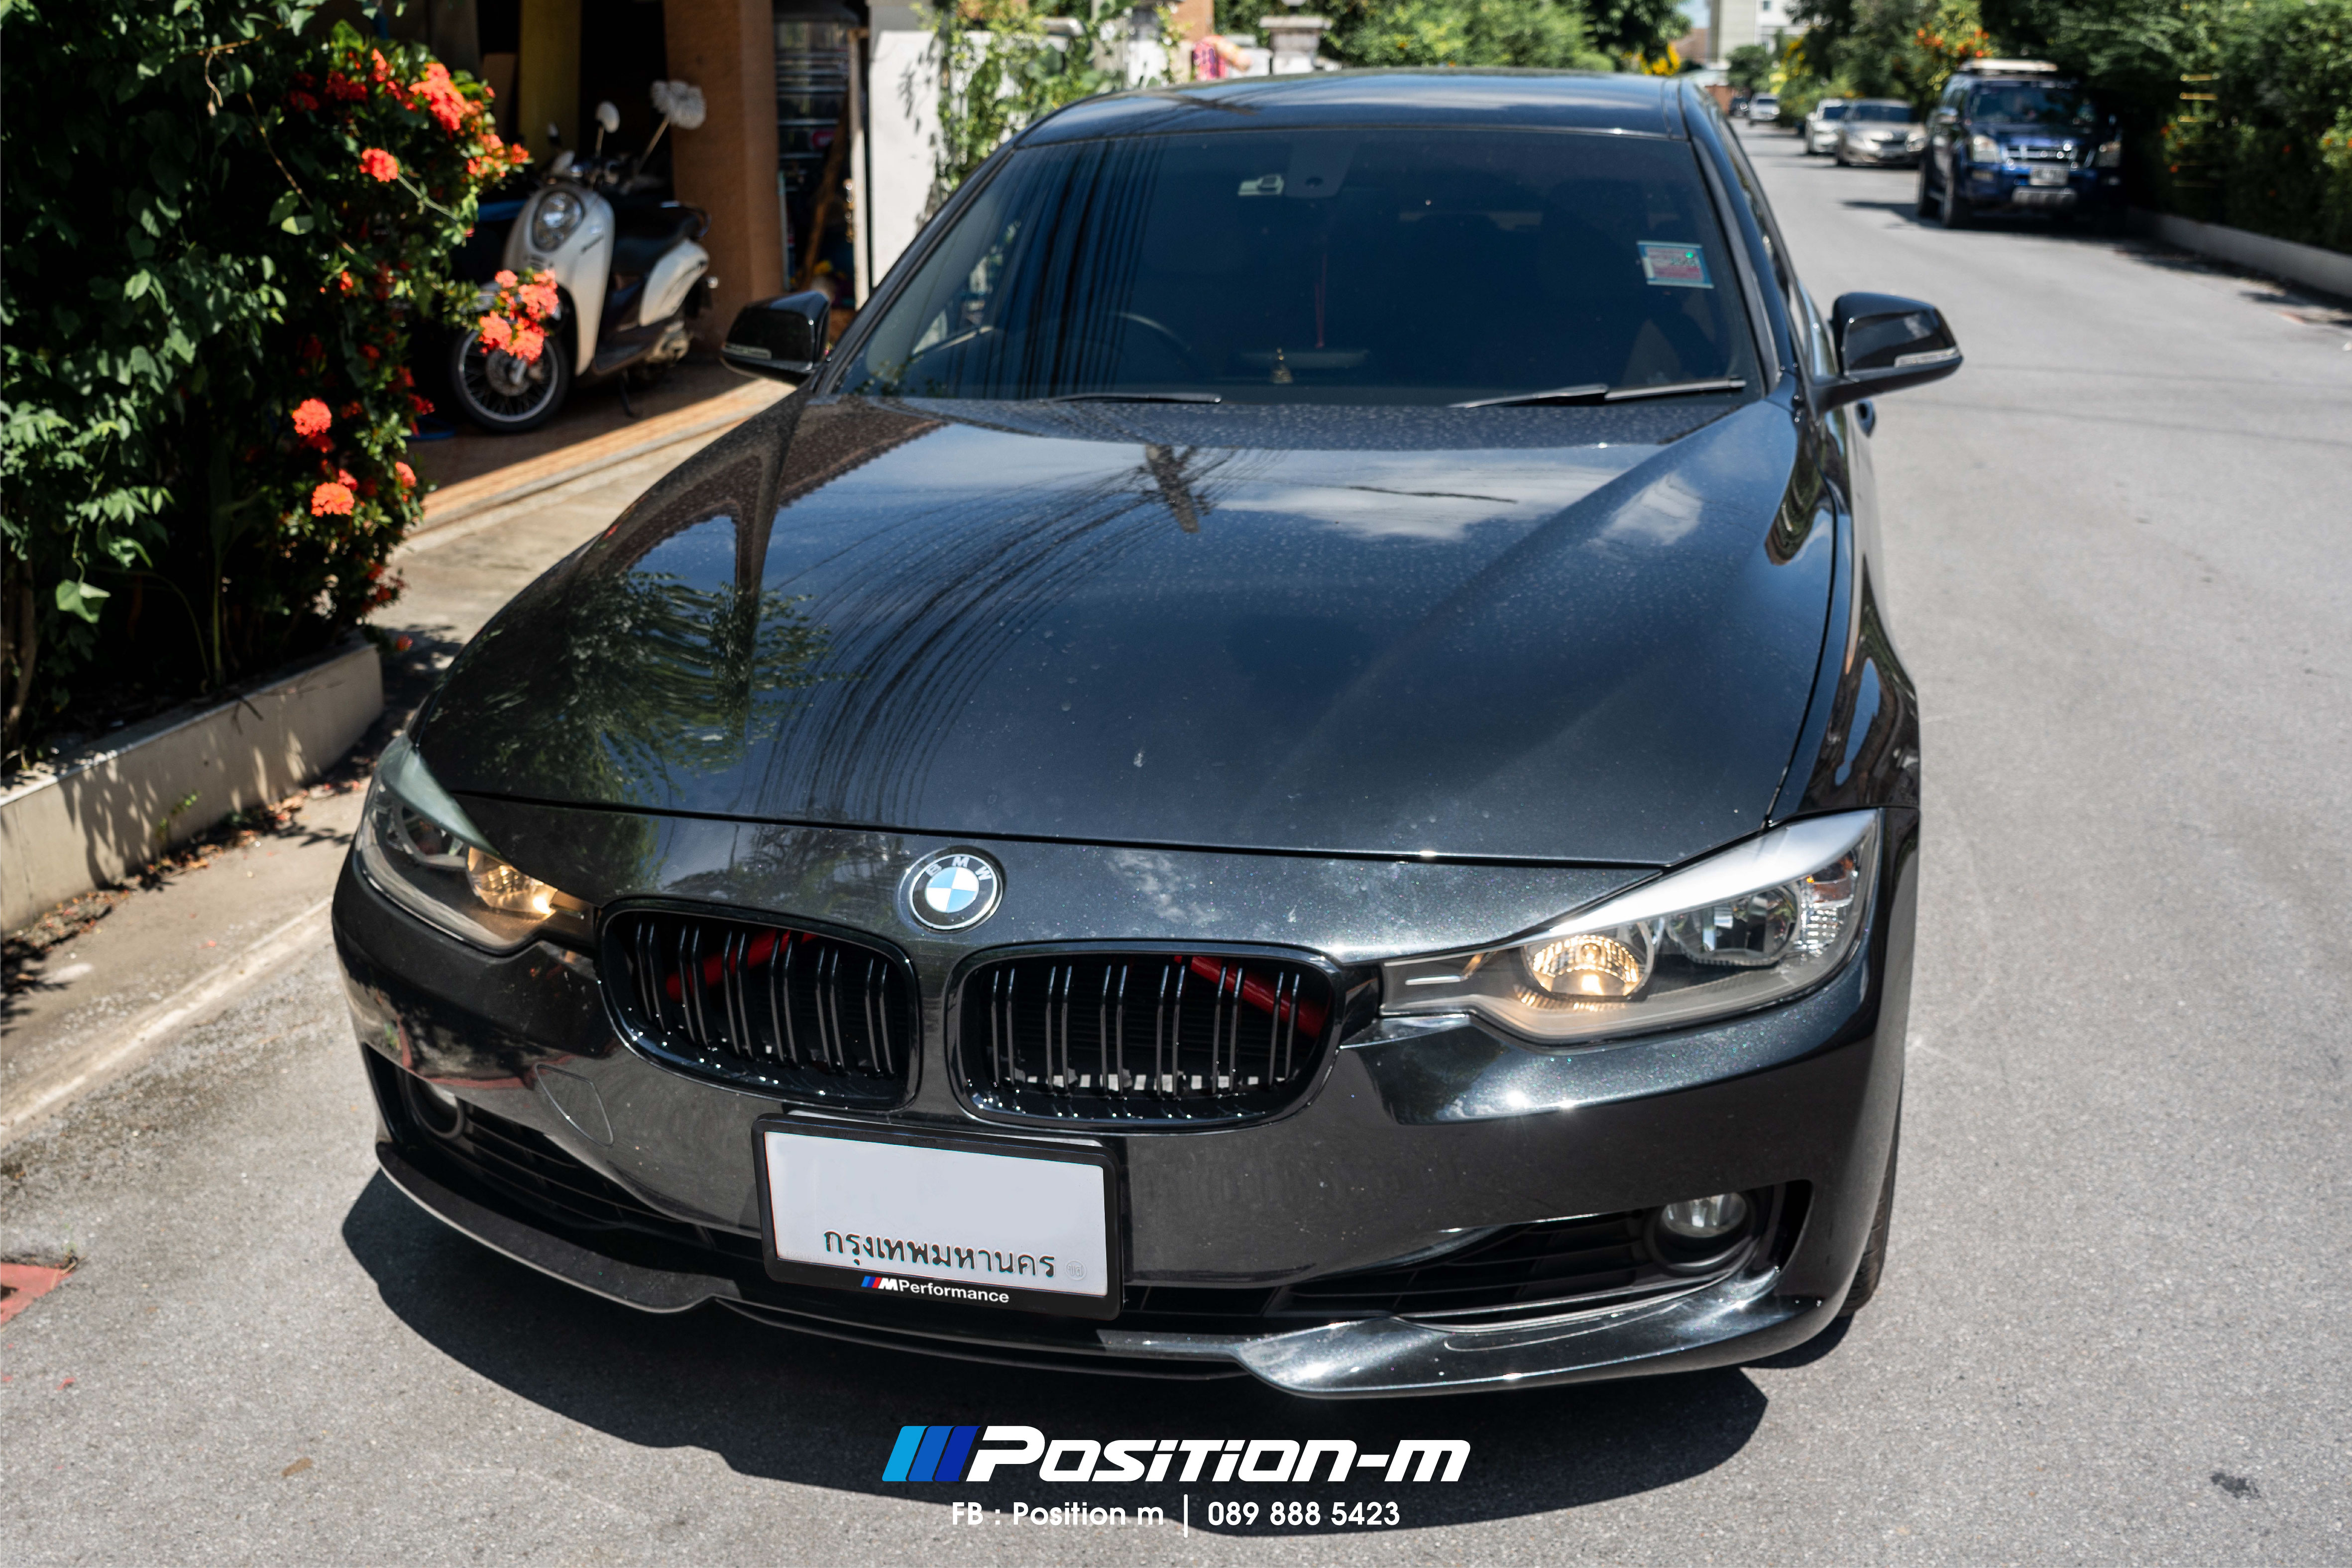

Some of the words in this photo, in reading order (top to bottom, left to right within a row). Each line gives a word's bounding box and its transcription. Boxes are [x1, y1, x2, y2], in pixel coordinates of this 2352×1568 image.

[925, 856, 992, 881] BMW
[824, 1231, 1055, 1277] กรุงเทพมหานคร
